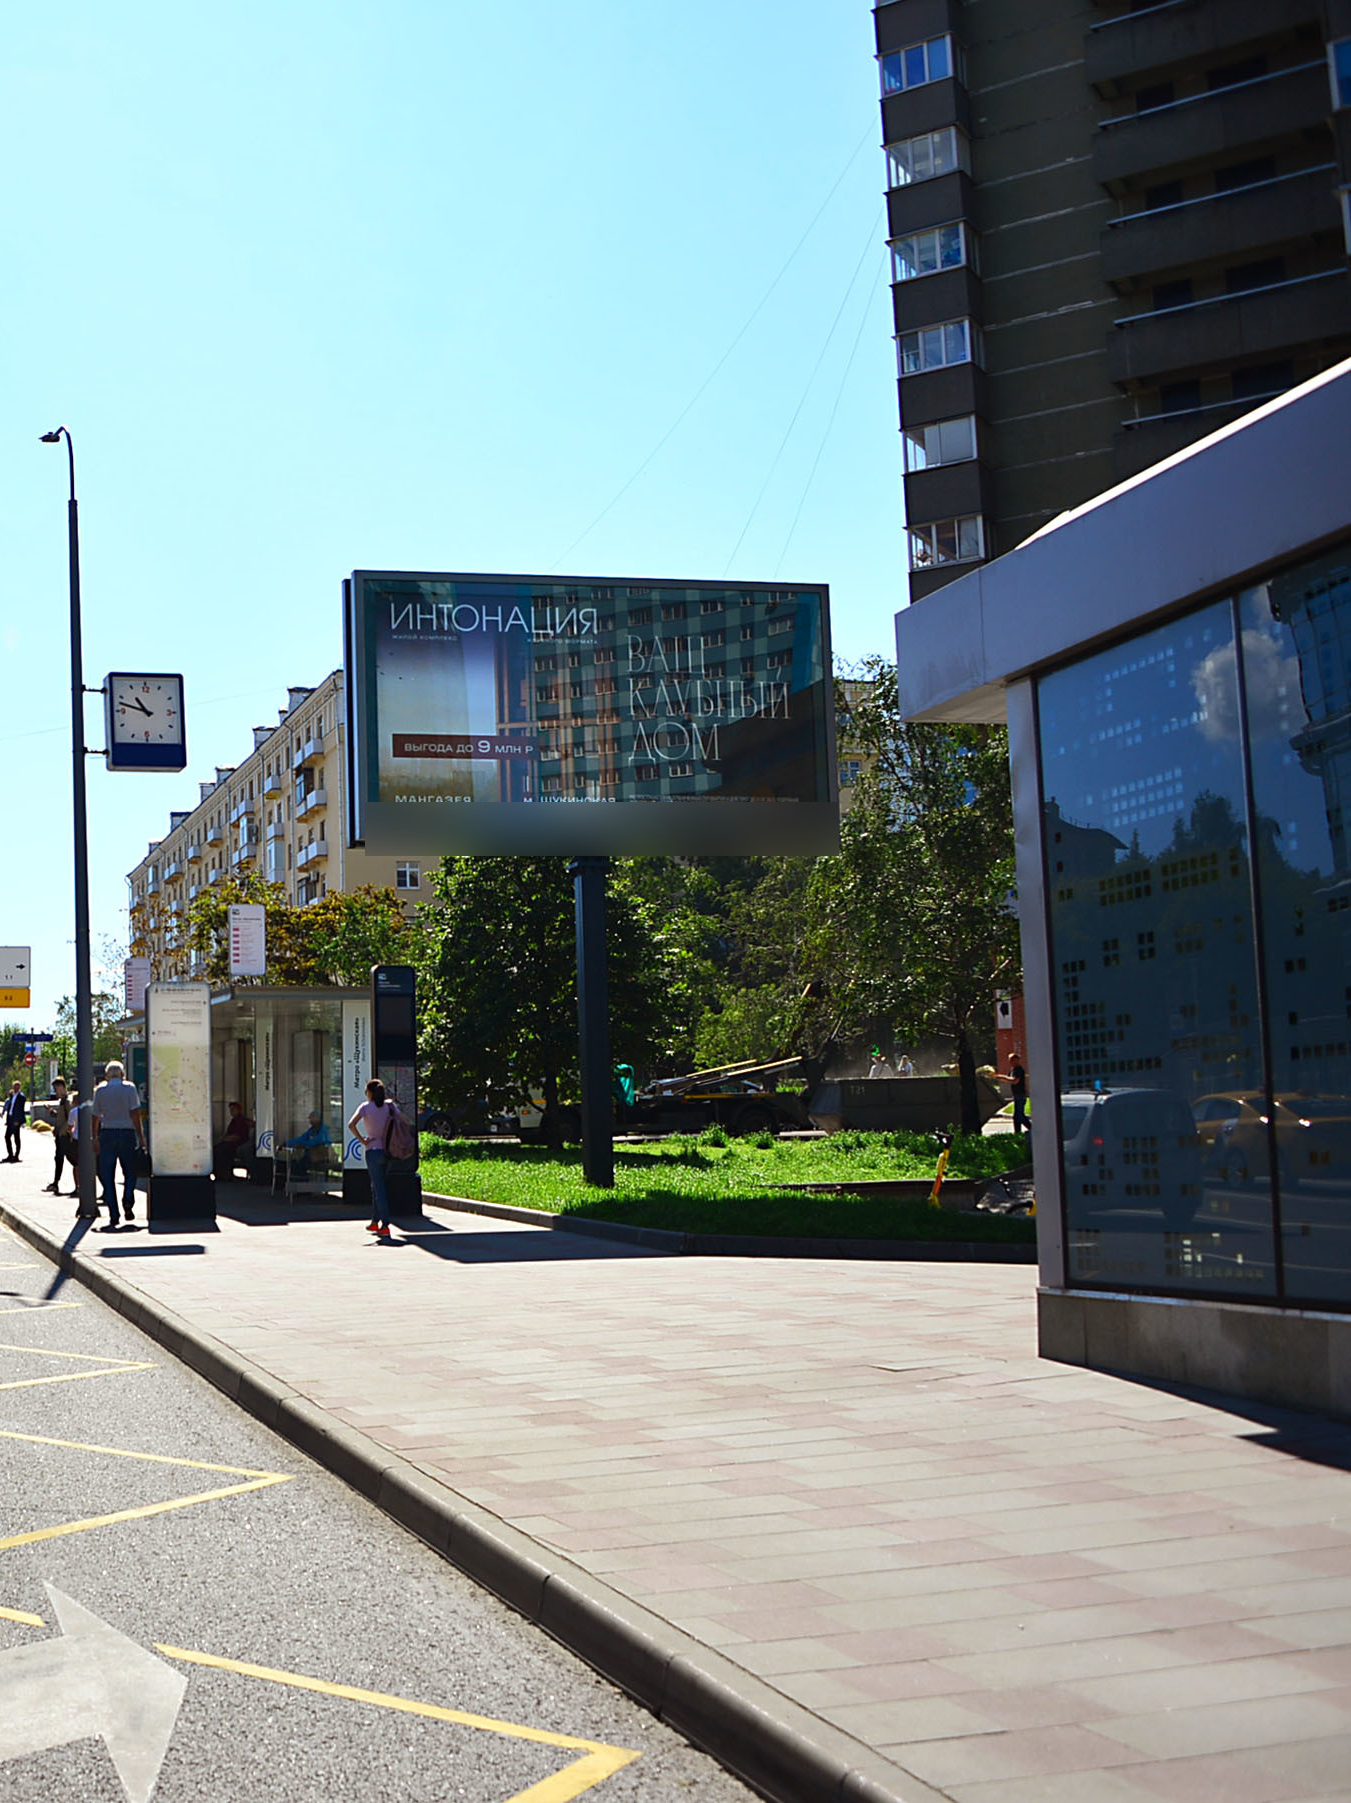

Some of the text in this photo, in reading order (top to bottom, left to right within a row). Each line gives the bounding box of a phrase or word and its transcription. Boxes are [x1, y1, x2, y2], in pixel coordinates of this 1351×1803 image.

[390, 603, 598, 636] ИНТОНАЦИЯ
[626, 634, 707, 674] ВАШ
[627, 665, 791, 719] КЛУБНЫЙ
[404, 743, 453, 753] ВЫГОДА
[456, 744, 474, 754] ДО
[477, 740, 491, 753] 9
[495, 745, 521, 754] МЛН
[627, 721, 722, 767] ДОМ
